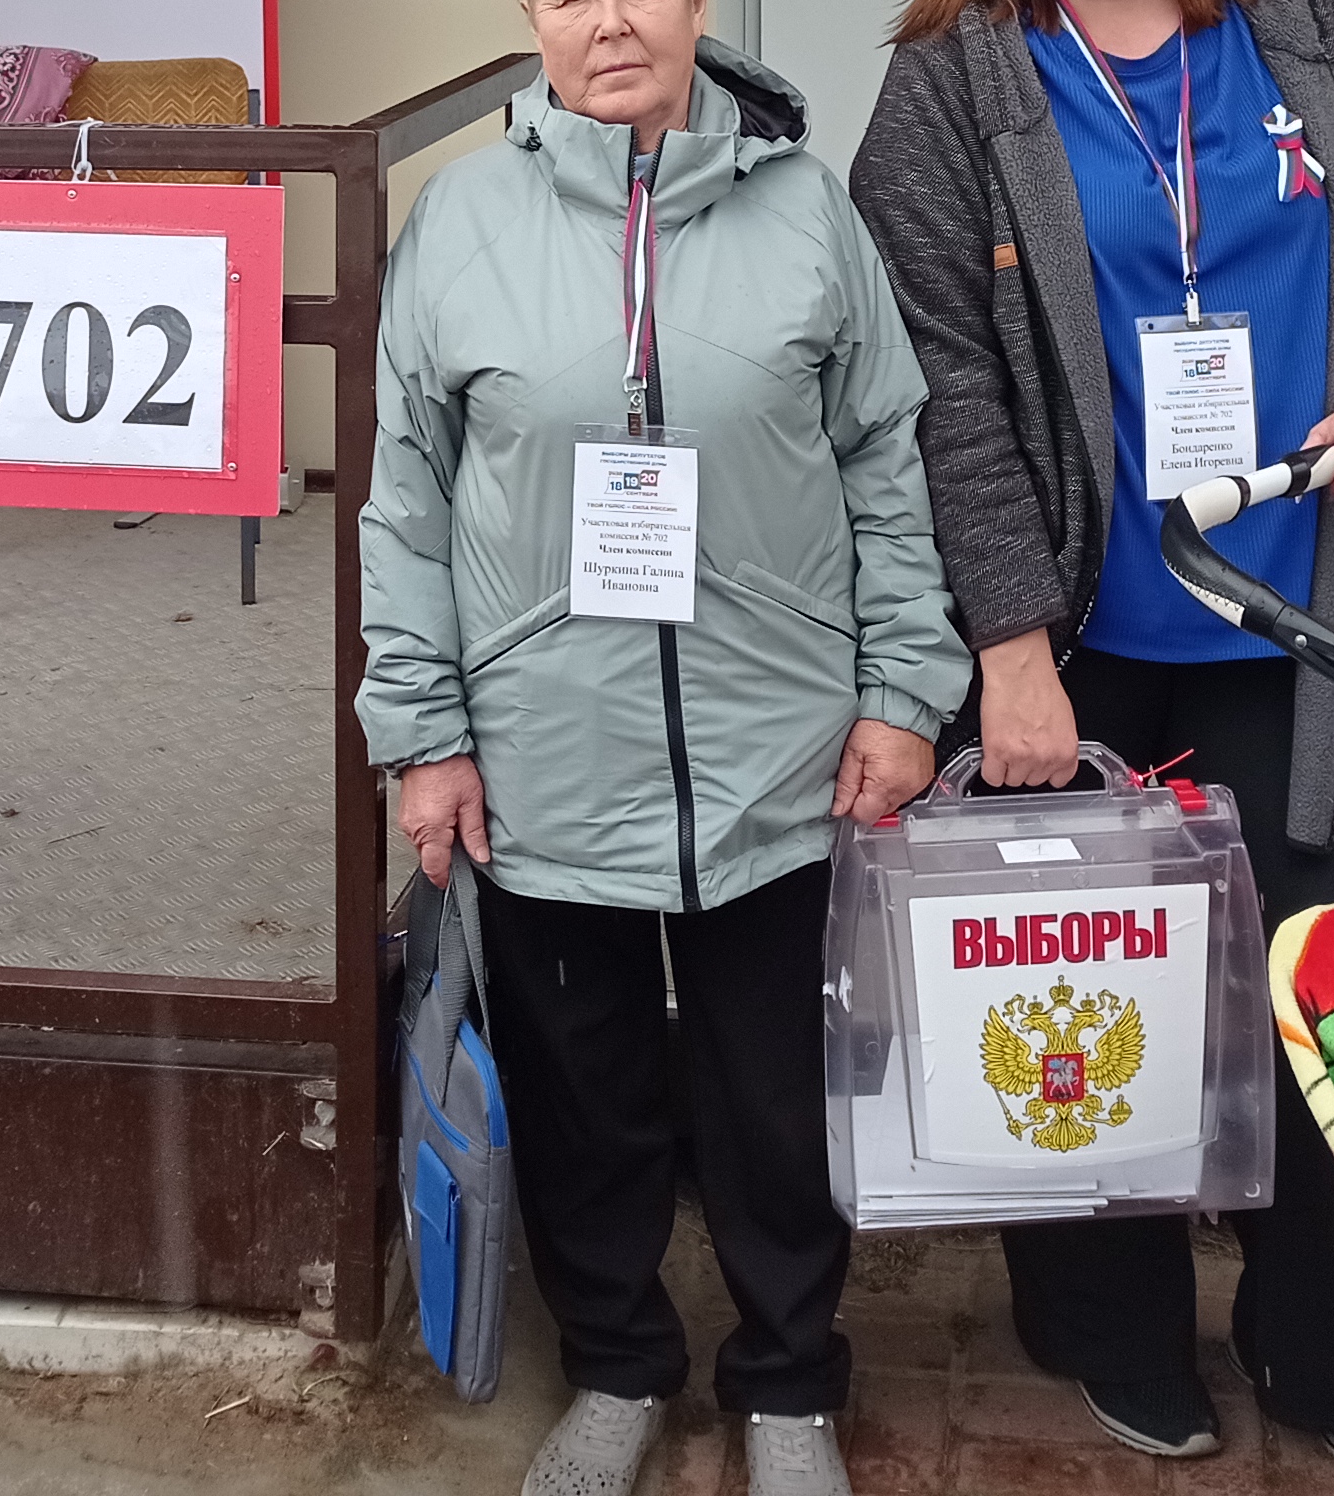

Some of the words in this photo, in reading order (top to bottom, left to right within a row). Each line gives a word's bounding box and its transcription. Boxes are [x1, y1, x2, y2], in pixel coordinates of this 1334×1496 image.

[1196, 362, 1208, 373] 19
[1209, 357, 1224, 368] 20
[1184, 368, 1195, 378] 18
[1220, 410, 1233, 418] 702
[1171, 426, 1193, 435] Член
[1171, 442, 1233, 455] Бондаренко
[1160, 459, 1192, 470] Елена
[1194, 457, 1244, 469] Игоревна
[624, 476, 639, 487] 19
[640, 472, 657, 484] 20
[609, 481, 623, 491] 18
[581, 517, 629, 528] Участковая
[630, 520, 691, 532] избирательная
[640, 533, 651, 542] №
[653, 533, 668, 542] 702
[599, 544, 623, 554] Член
[625, 547, 672, 557] комиссии
[583, 561, 639, 577] Шуркина
[642, 564, 684, 579] Галина
[602, 578, 659, 593] Ивановна
[952, 907, 1168, 970] ВЫБОРЫ
